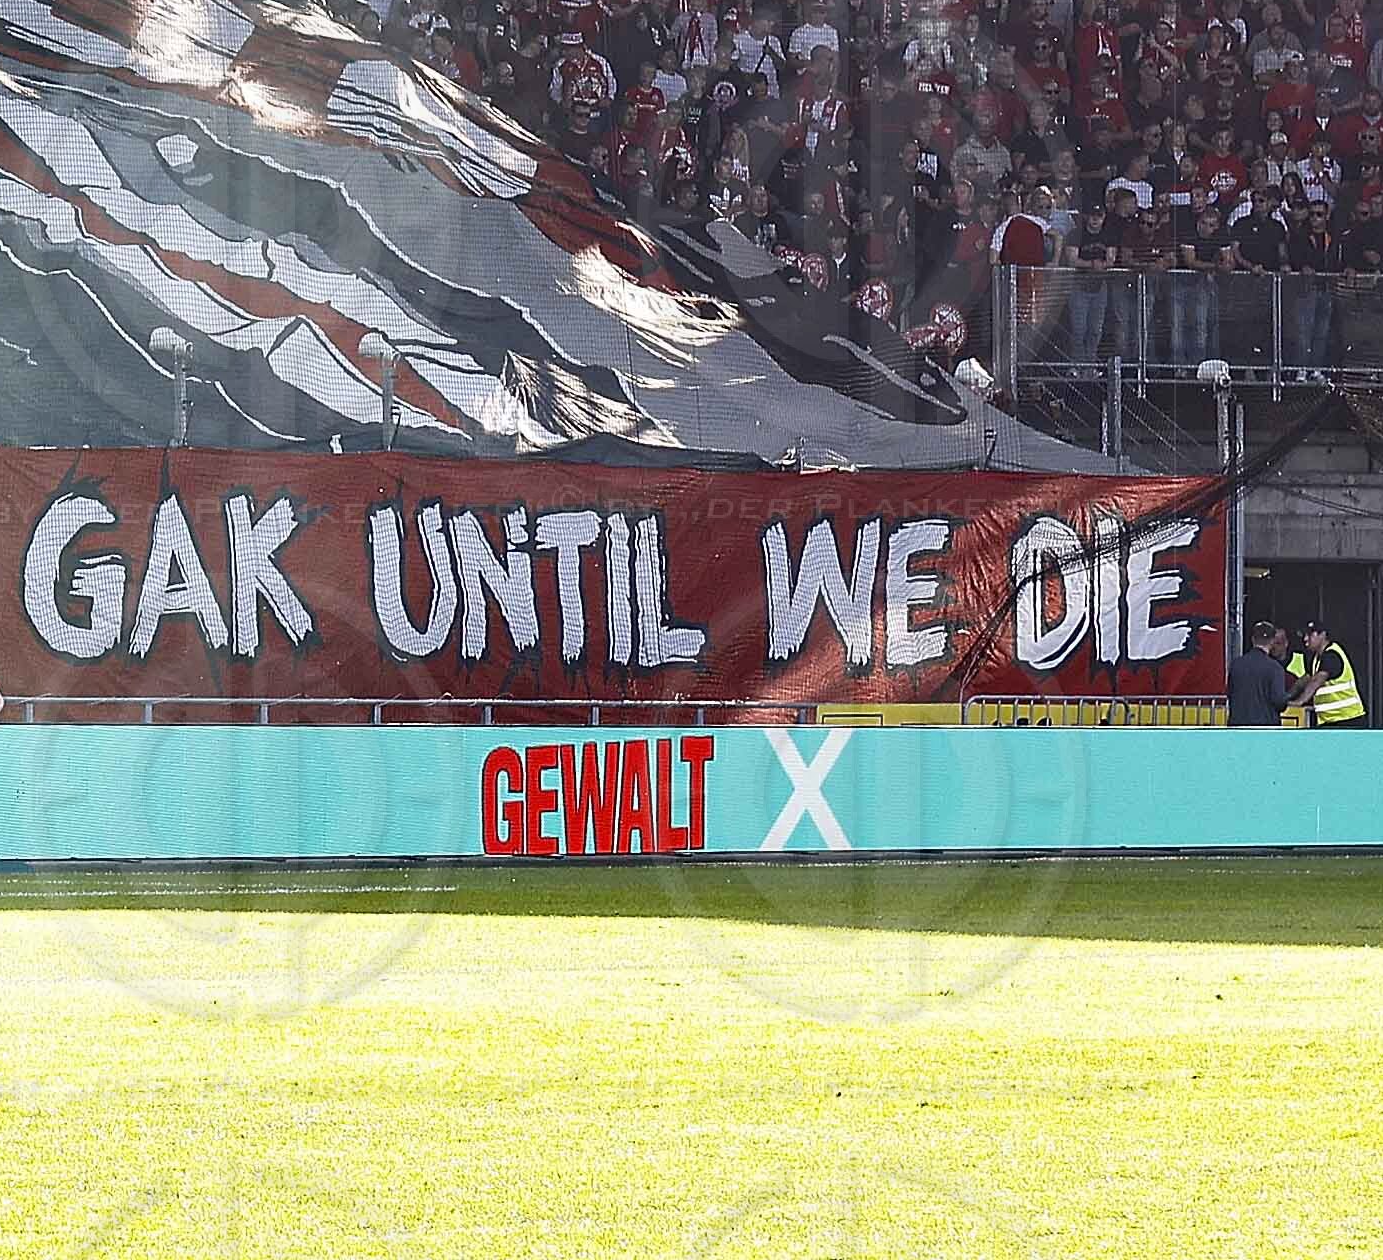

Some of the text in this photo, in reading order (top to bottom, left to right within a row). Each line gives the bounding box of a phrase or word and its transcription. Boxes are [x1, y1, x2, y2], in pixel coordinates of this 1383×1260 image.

[24, 491, 314, 658] GAK
[368, 501, 705, 666] UNTIL
[763, 518, 951, 669] WE
[1010, 513, 1201, 671] DIE
[481, 735, 715, 856] GEWALT
